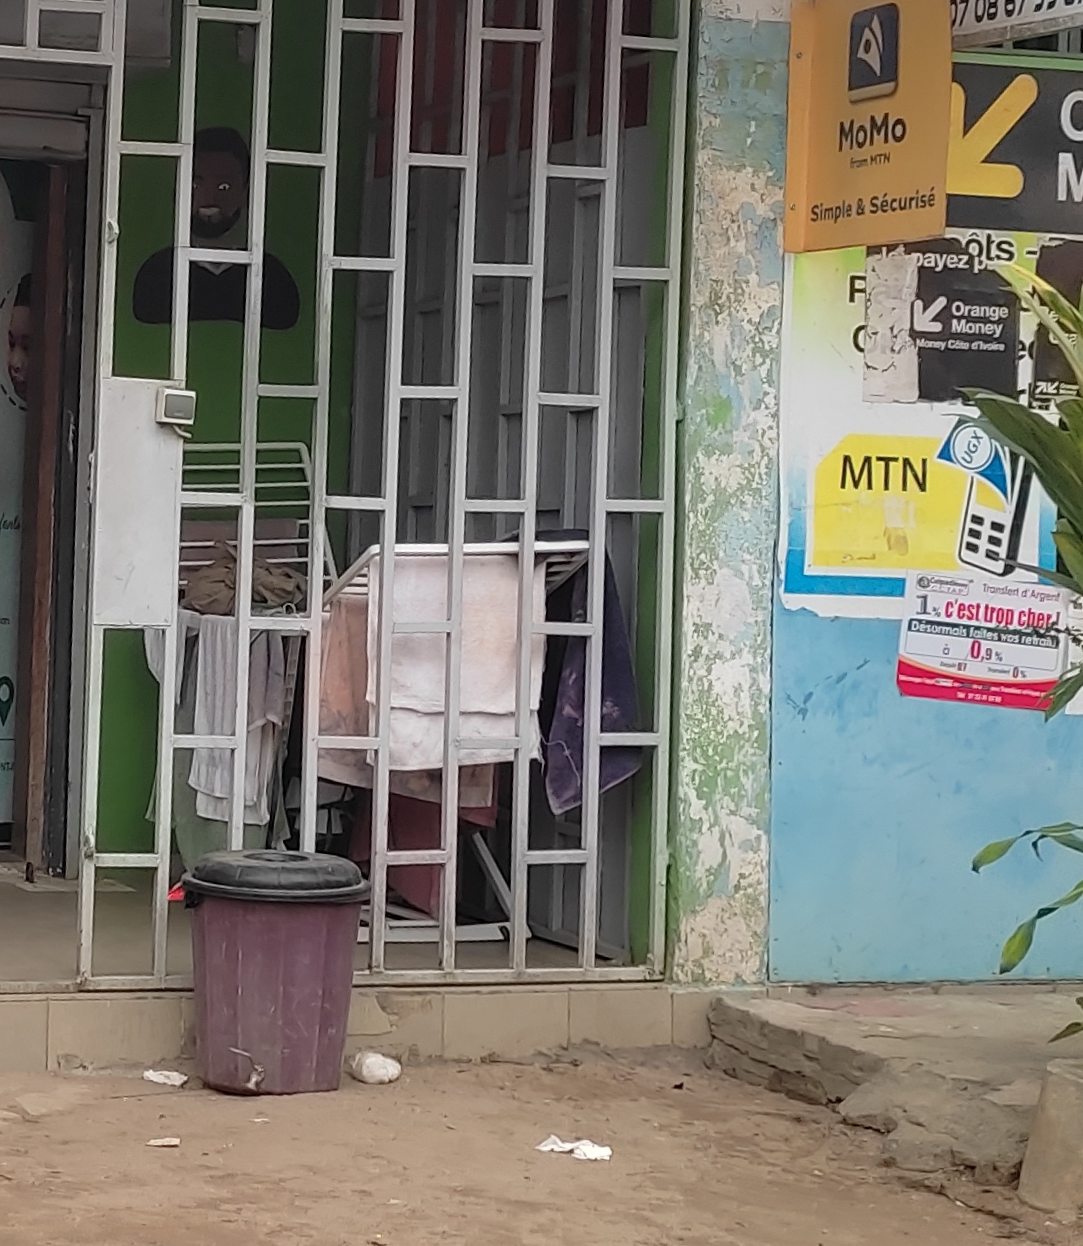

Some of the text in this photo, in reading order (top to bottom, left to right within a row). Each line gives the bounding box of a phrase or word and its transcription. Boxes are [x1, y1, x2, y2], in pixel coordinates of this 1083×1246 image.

[838, 112, 906, 152] MoMo
[870, 152, 891, 165] MTN
[810, 186, 936, 224] Simple & Sécurisé
[951, 301, 1009, 320] Orange
[951, 319, 1004, 337] Money
[948, 339, 968, 351] Côte
[963, 432, 985, 465] UGX
[840, 454, 928, 492] MTN
[945, 598, 981, 621] c'est
[984, 604, 1014, 626] trop
[911, 620, 967, 637] Désormais
[969, 626, 998, 640] faites
[1001, 633, 1019, 643] vos
